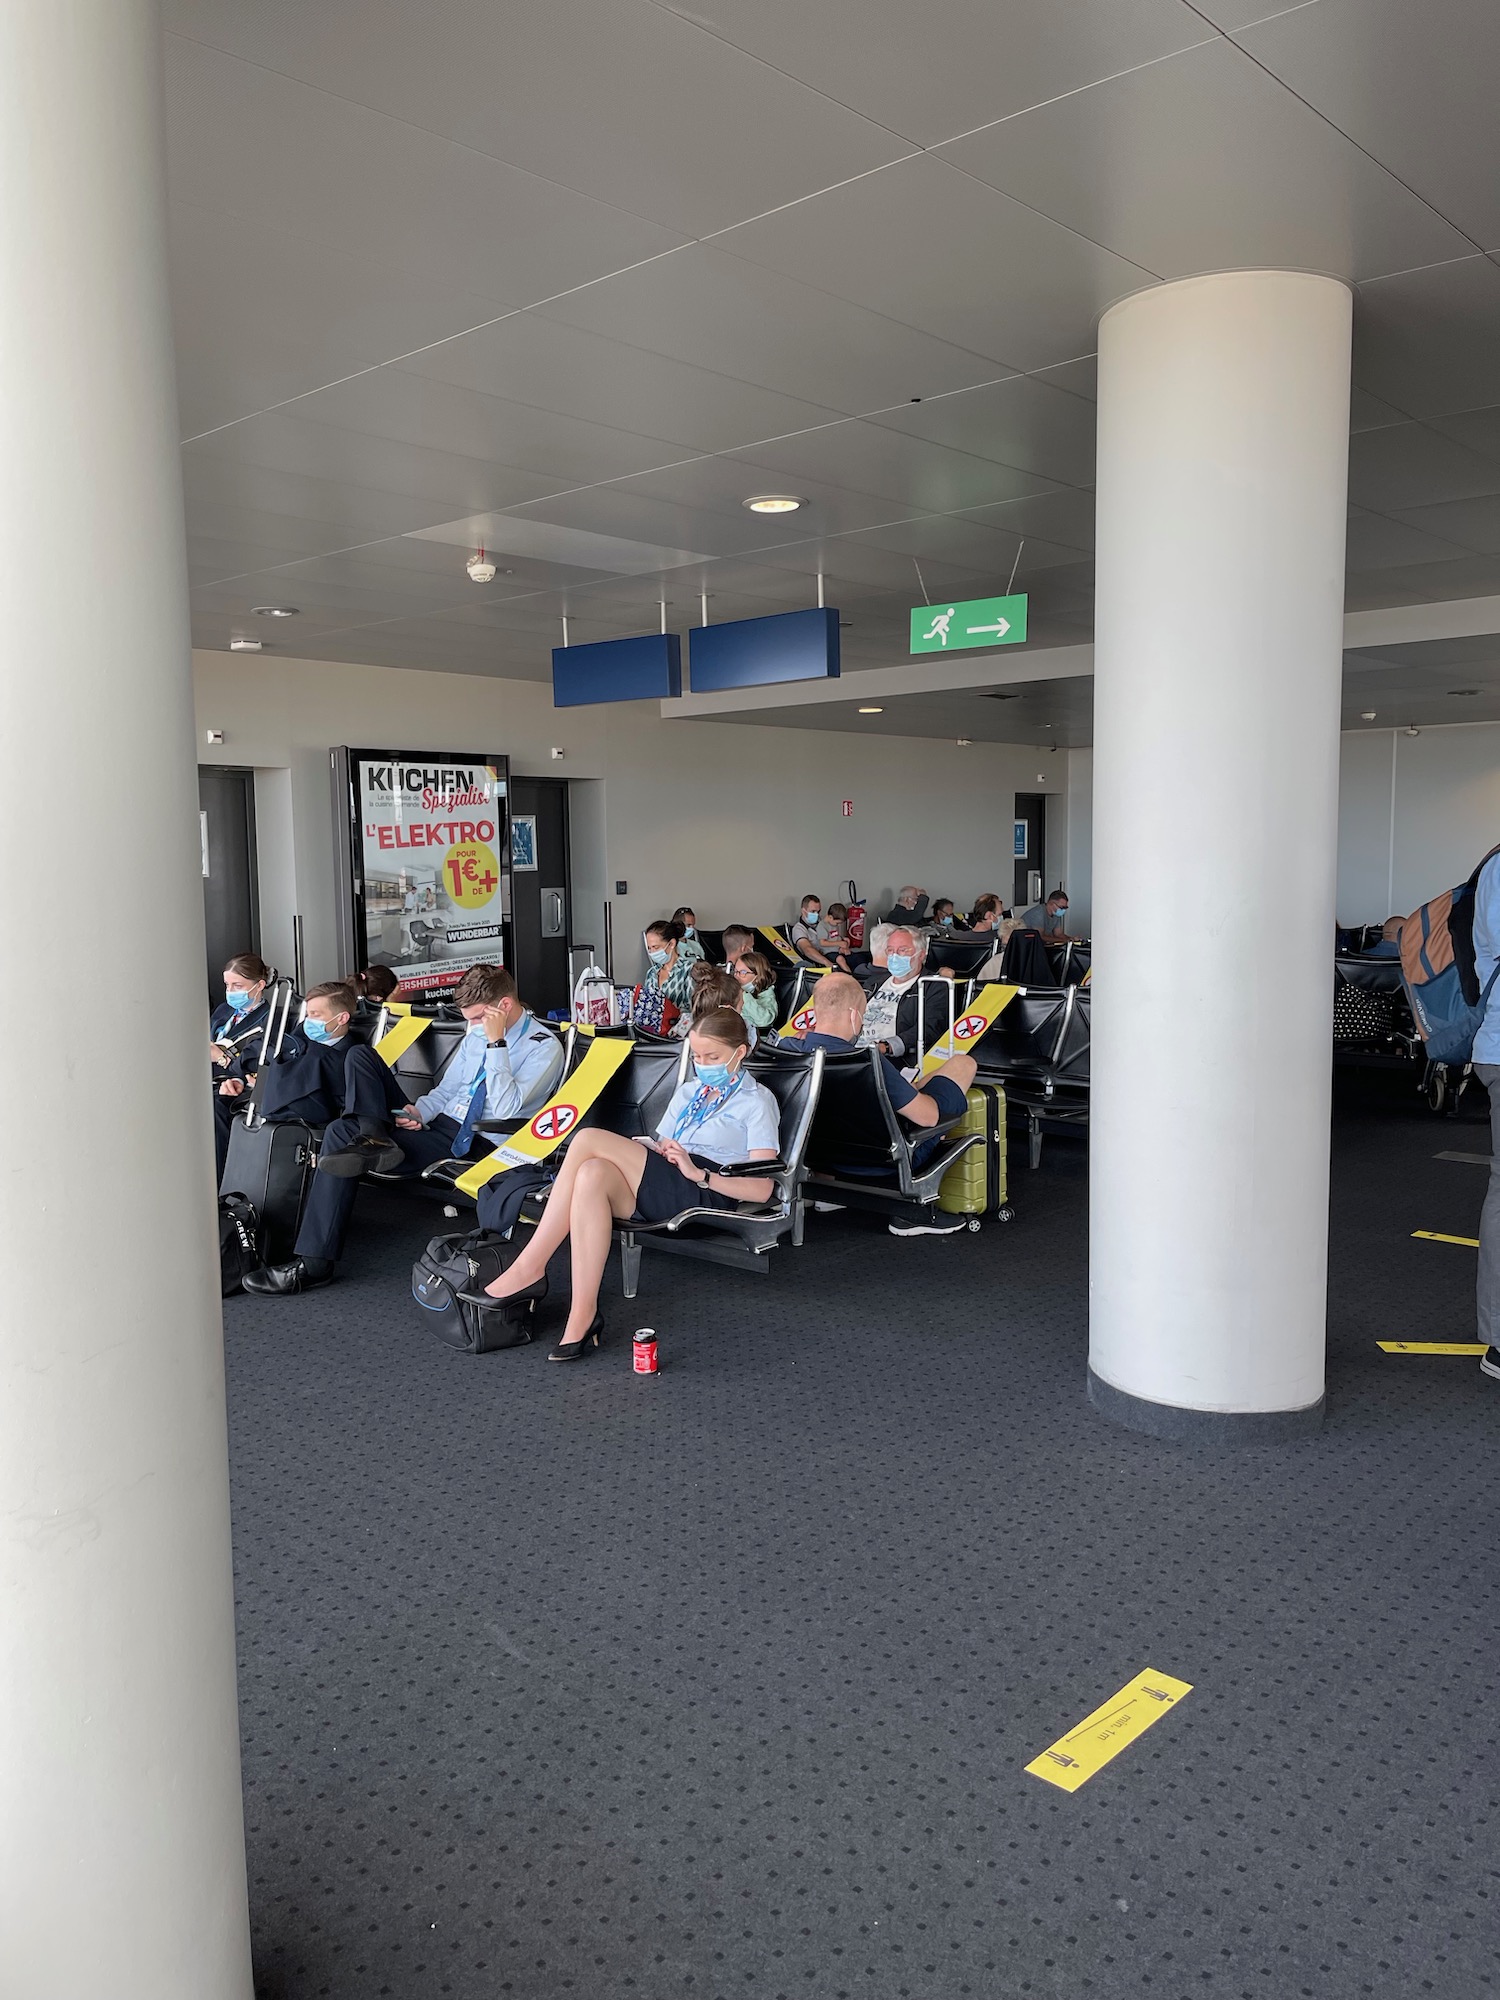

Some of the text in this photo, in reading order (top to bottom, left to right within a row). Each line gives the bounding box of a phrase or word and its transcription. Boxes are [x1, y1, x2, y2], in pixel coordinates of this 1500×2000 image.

[368, 763, 474, 793] KÜCHEN
[456, 850, 477, 858] POUR
[472, 887, 483, 896] DE
[447, 927, 499, 941] WUNDERBAR
[400, 976, 440, 991] ERSHEIM
[236, 1220, 250, 1247] CREW
[1110, 1714, 1132, 1728] min.
